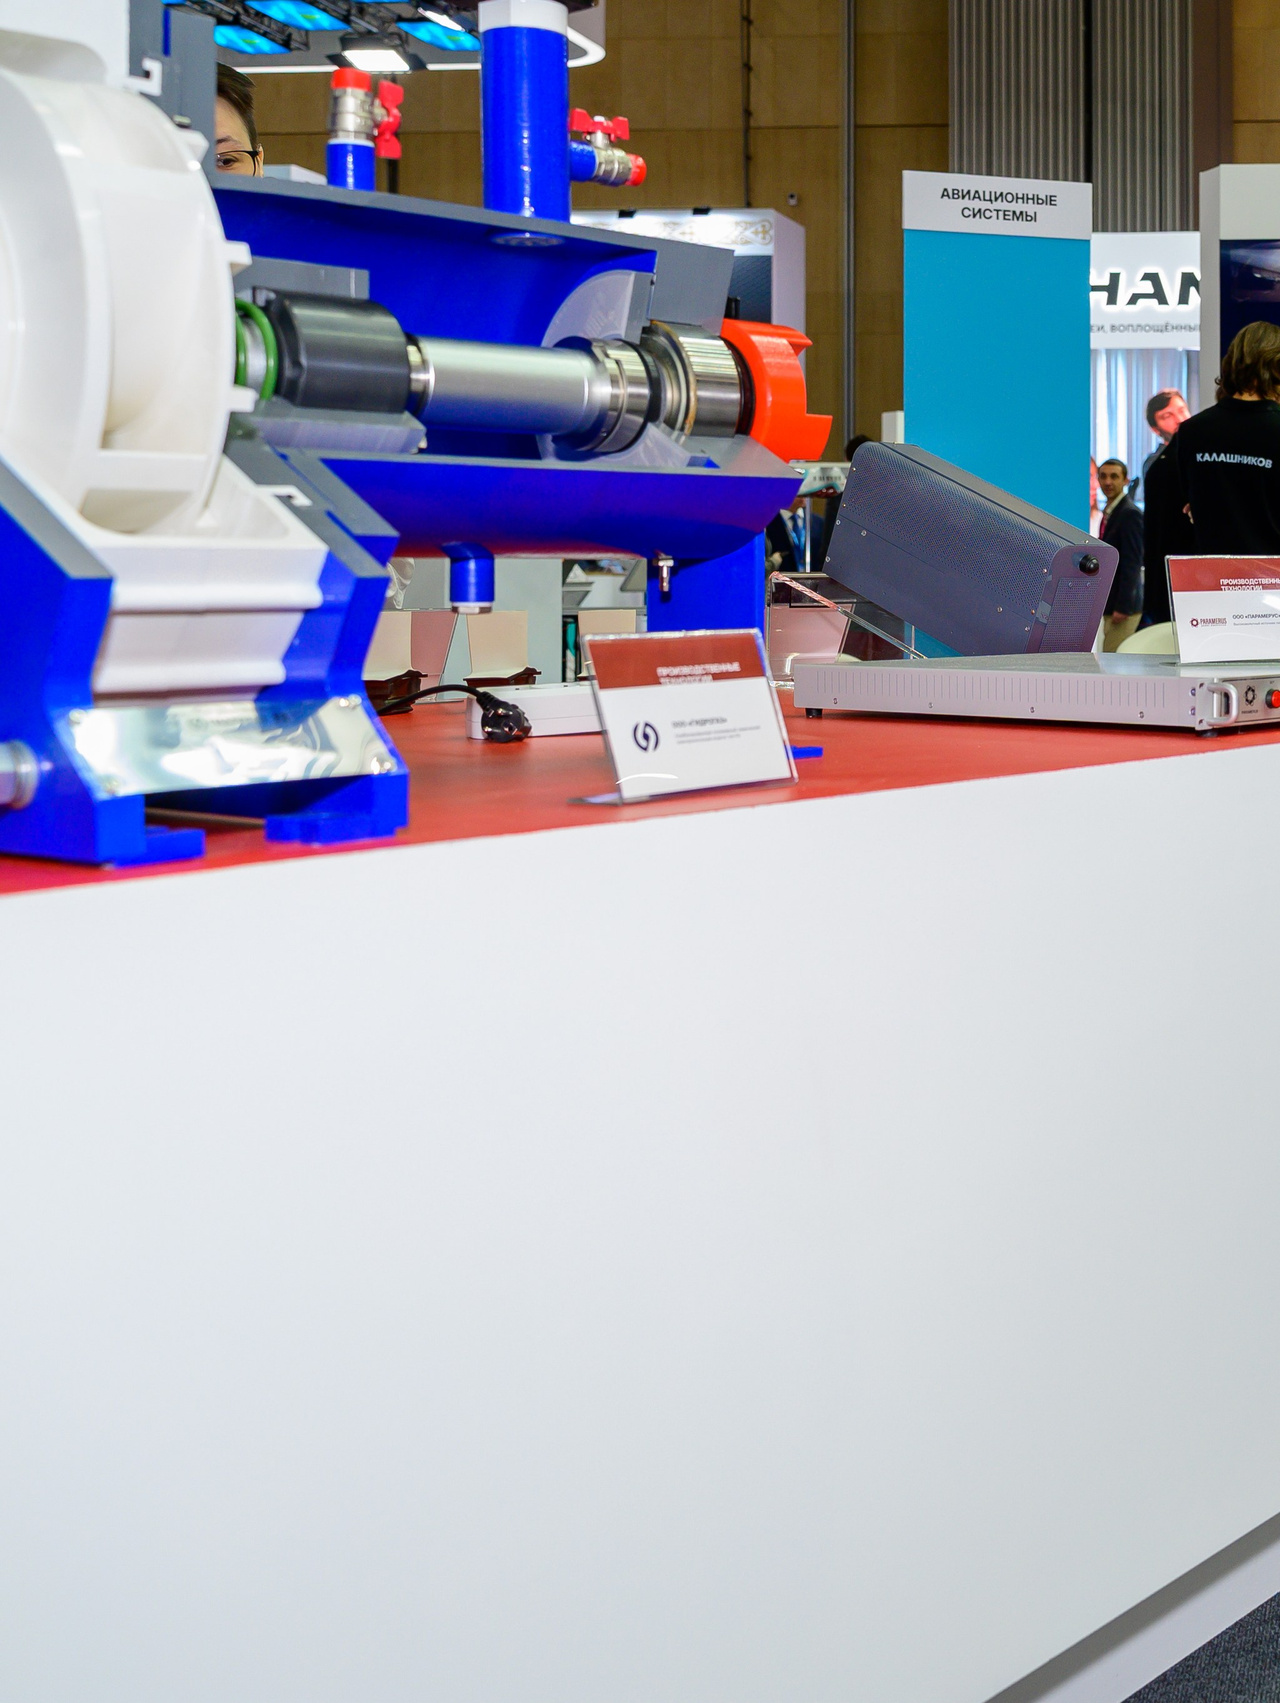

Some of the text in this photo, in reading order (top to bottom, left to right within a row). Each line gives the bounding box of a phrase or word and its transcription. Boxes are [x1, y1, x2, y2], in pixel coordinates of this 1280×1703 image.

[940, 188, 1058, 206] АВИАЦИОННЫЕ
[961, 206, 1037, 223] СИСТЕМЫ
[1110, 322, 1200, 334] ВОПЛОЩЁННЫ
[1196, 453, 1273, 469] КАЛАШНИКОВ
[1200, 617, 1227, 625] PARAMERUS
